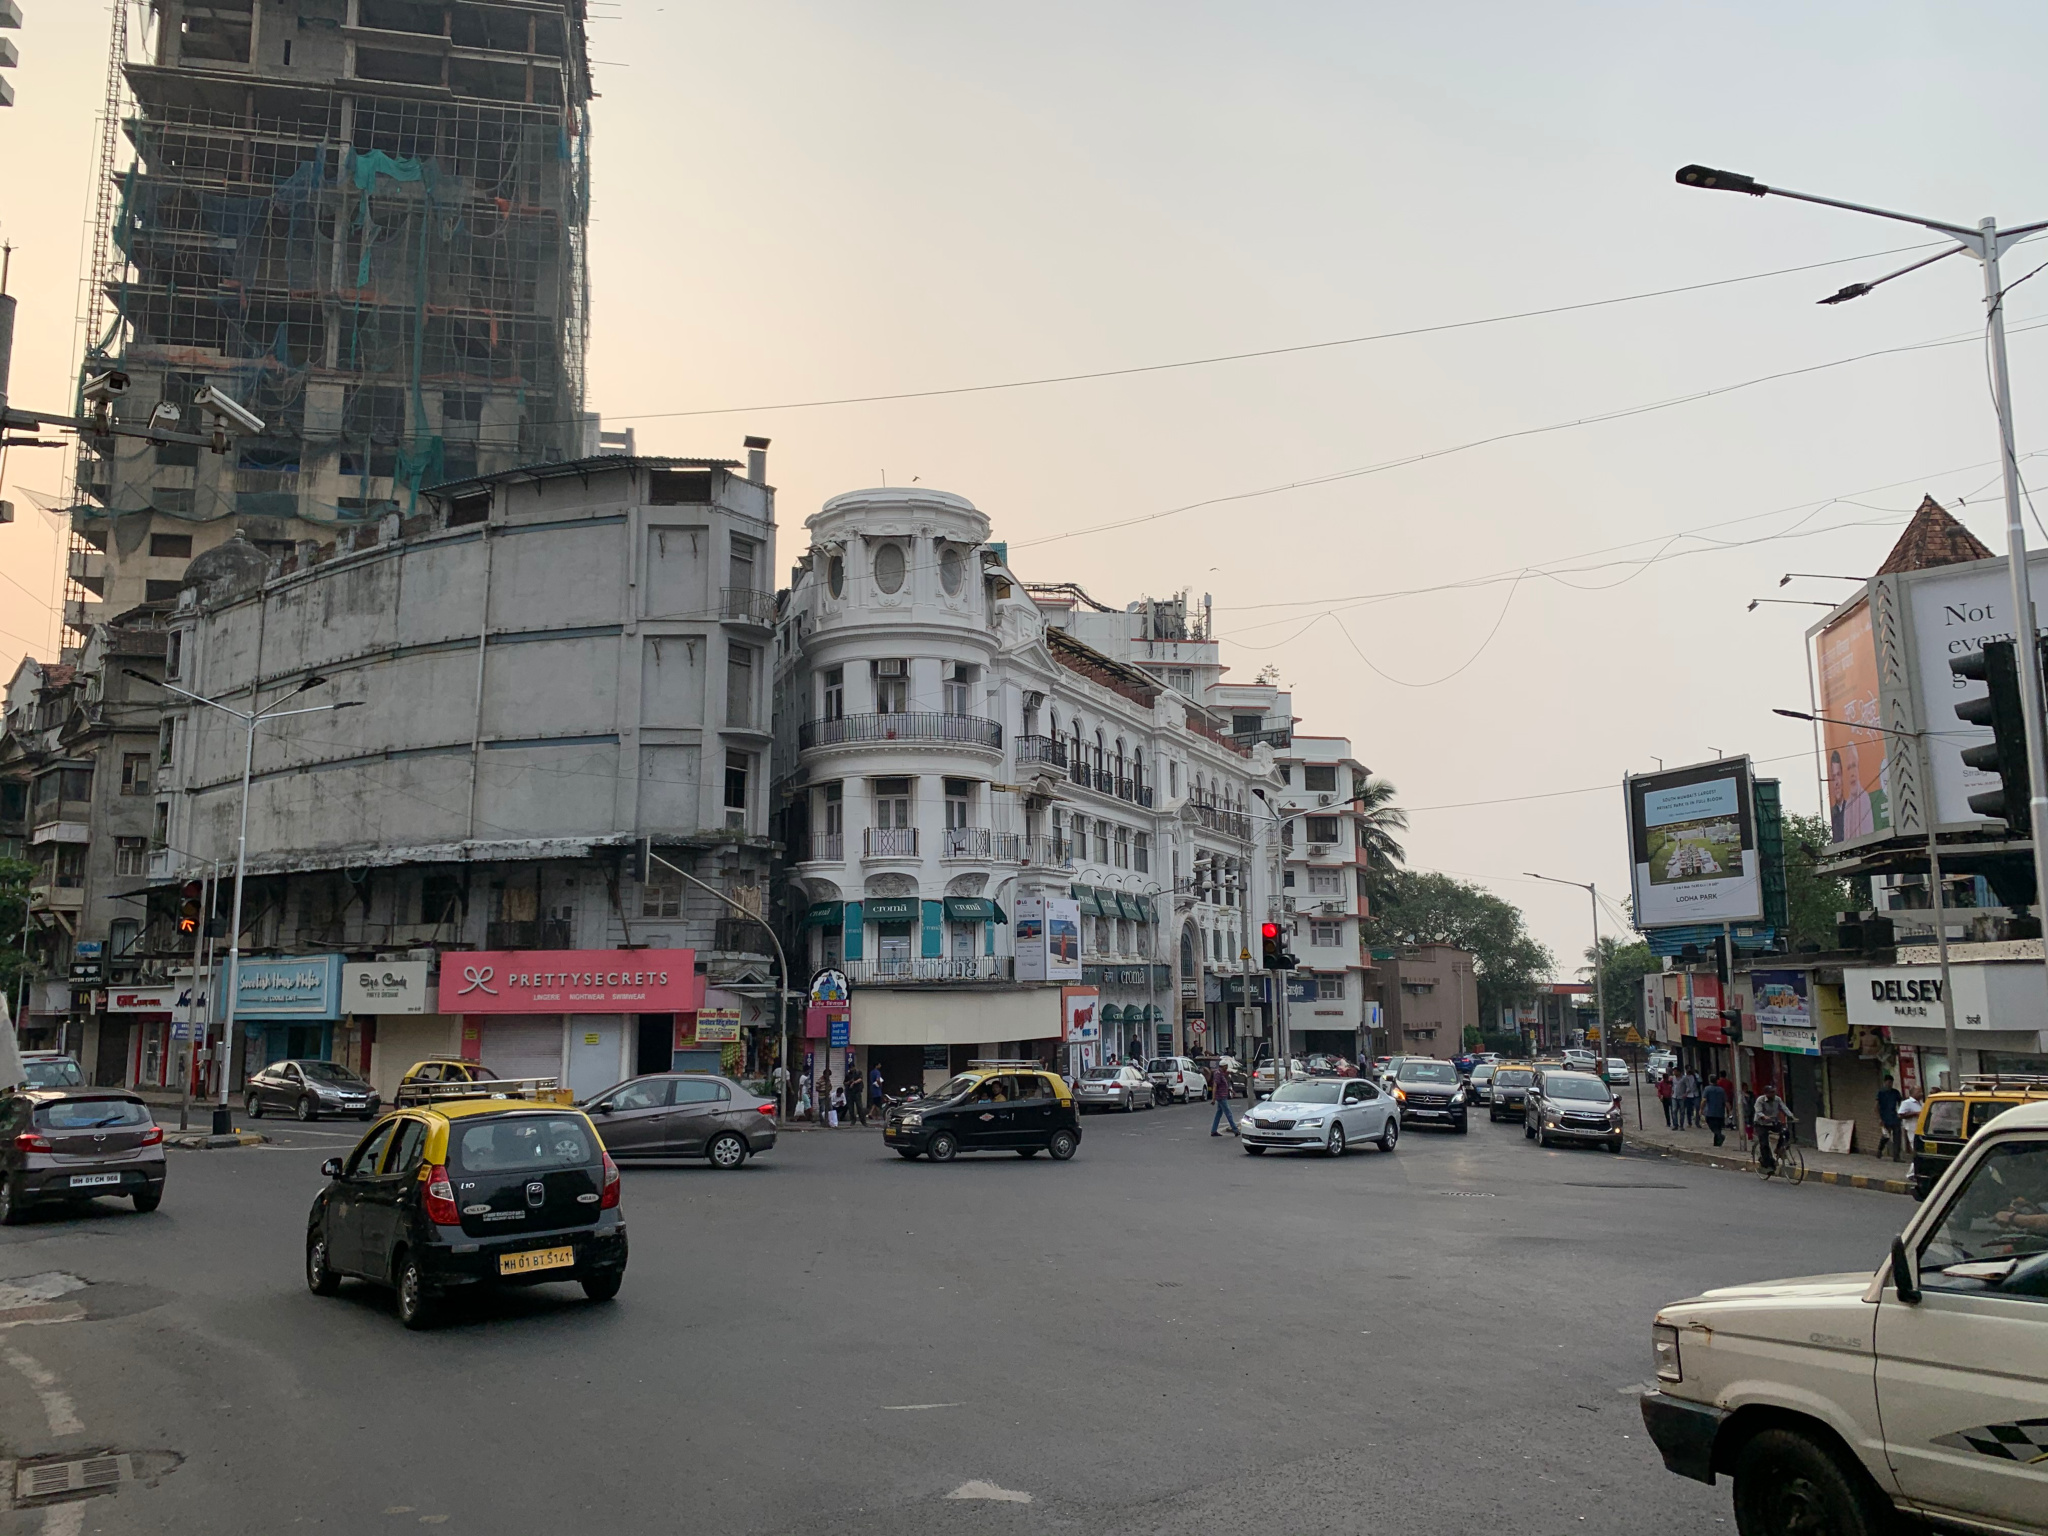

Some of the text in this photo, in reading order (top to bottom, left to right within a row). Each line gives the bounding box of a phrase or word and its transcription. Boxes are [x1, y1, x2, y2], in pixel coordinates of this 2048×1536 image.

[1943, 602, 1996, 627] Not
[1697, 789, 1717, 797] LARGEST
[1656, 803, 1673, 811] PRIVATE
[1675, 893, 1718, 903] LODHA PARK
[872, 902, 908, 913] cromā
[954, 902, 981, 911] cromā
[508, 971, 668, 987] PRETTYSECRETS
[1120, 967, 1145, 984] cromā
[1871, 979, 1944, 1002] DELSEY
[569, 993, 605, 1001] NIGHTWEAR
[503, 1258, 516, 1271] MH
[518, 1255, 531, 1269] 01
[533, 1255, 545, 1268] BT
